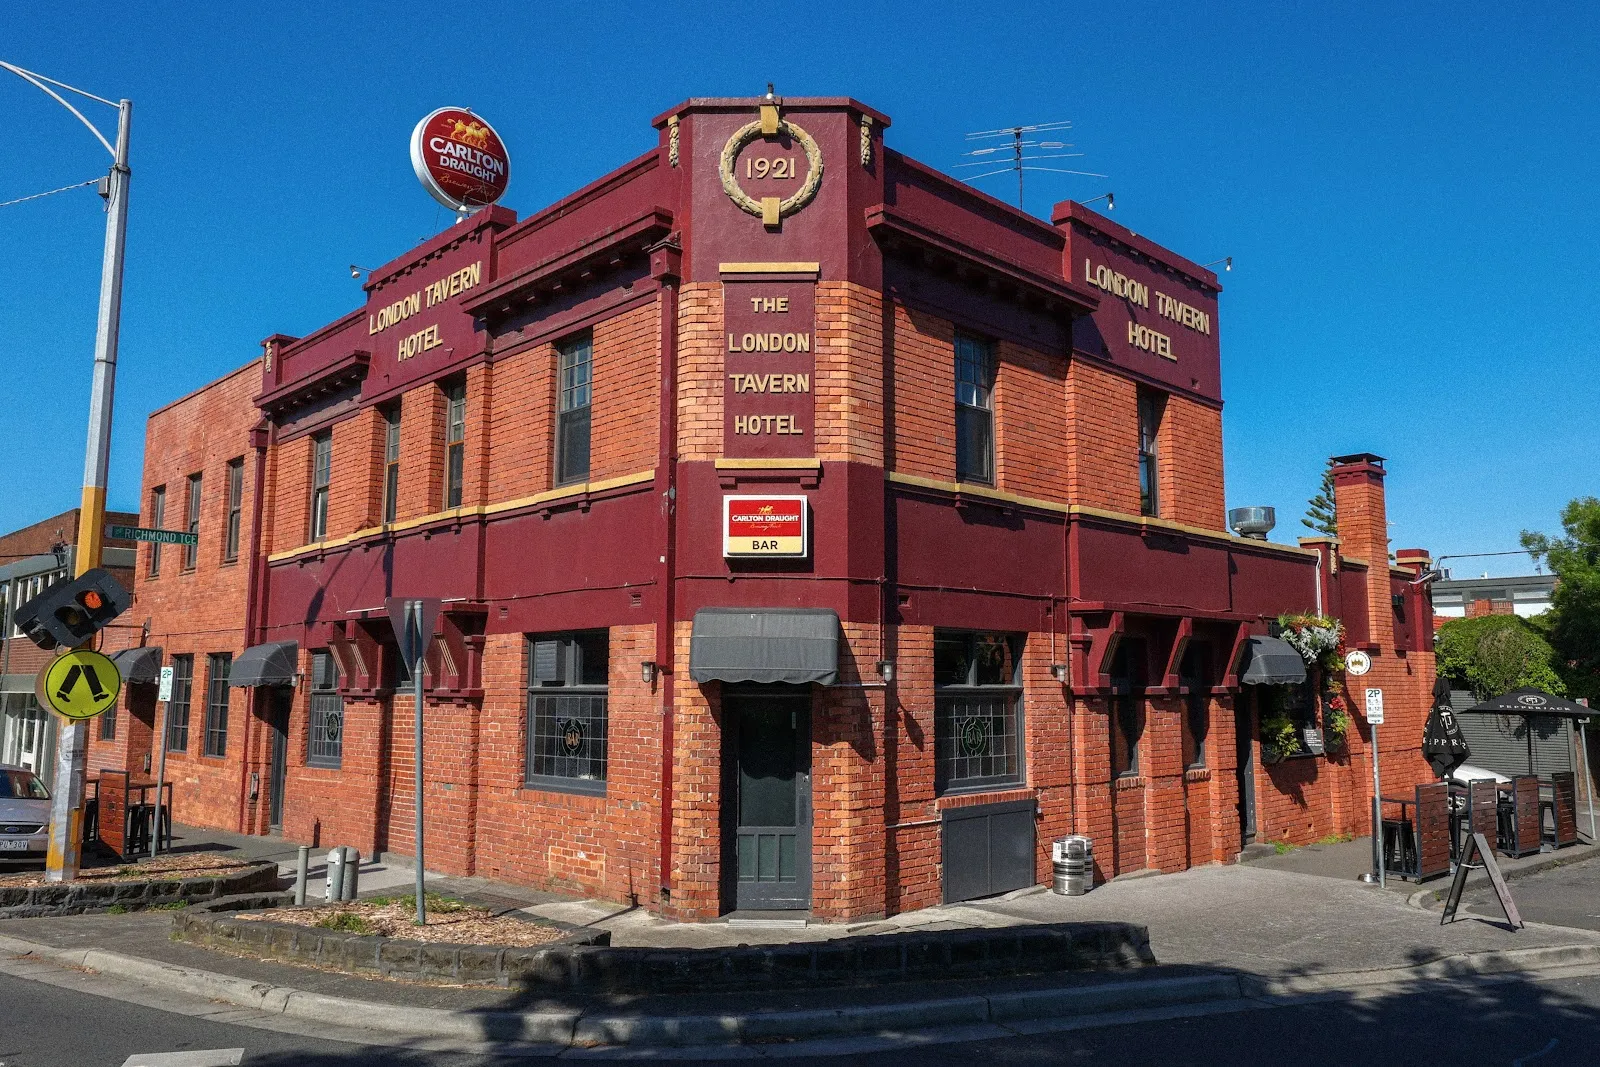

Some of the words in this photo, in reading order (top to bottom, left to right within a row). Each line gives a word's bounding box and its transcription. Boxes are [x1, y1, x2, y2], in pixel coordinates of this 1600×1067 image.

[430, 137, 504, 175] CARLTON
[440, 155, 496, 183] DRAUGHT
[747, 158, 795, 178] 1921
[369, 290, 421, 335] LONDON
[425, 260, 482, 308] TAVERN
[751, 297, 789, 312] THE
[1085, 258, 1149, 309] LONDON
[1155, 290, 1210, 335] TAVERN
[398, 324, 443, 362] HOTEL
[728, 333, 810, 352] LONDON
[1128, 321, 1178, 361] HOTEL
[729, 373, 810, 393] TAVERN
[734, 415, 803, 434] HOTEL
[124, 528, 177, 542] RICHMOND
[180, 533, 197, 545] TCE
[752, 540, 778, 550] BAR
[162, 669, 172, 679] 2P
[1367, 689, 1381, 698] 2P
